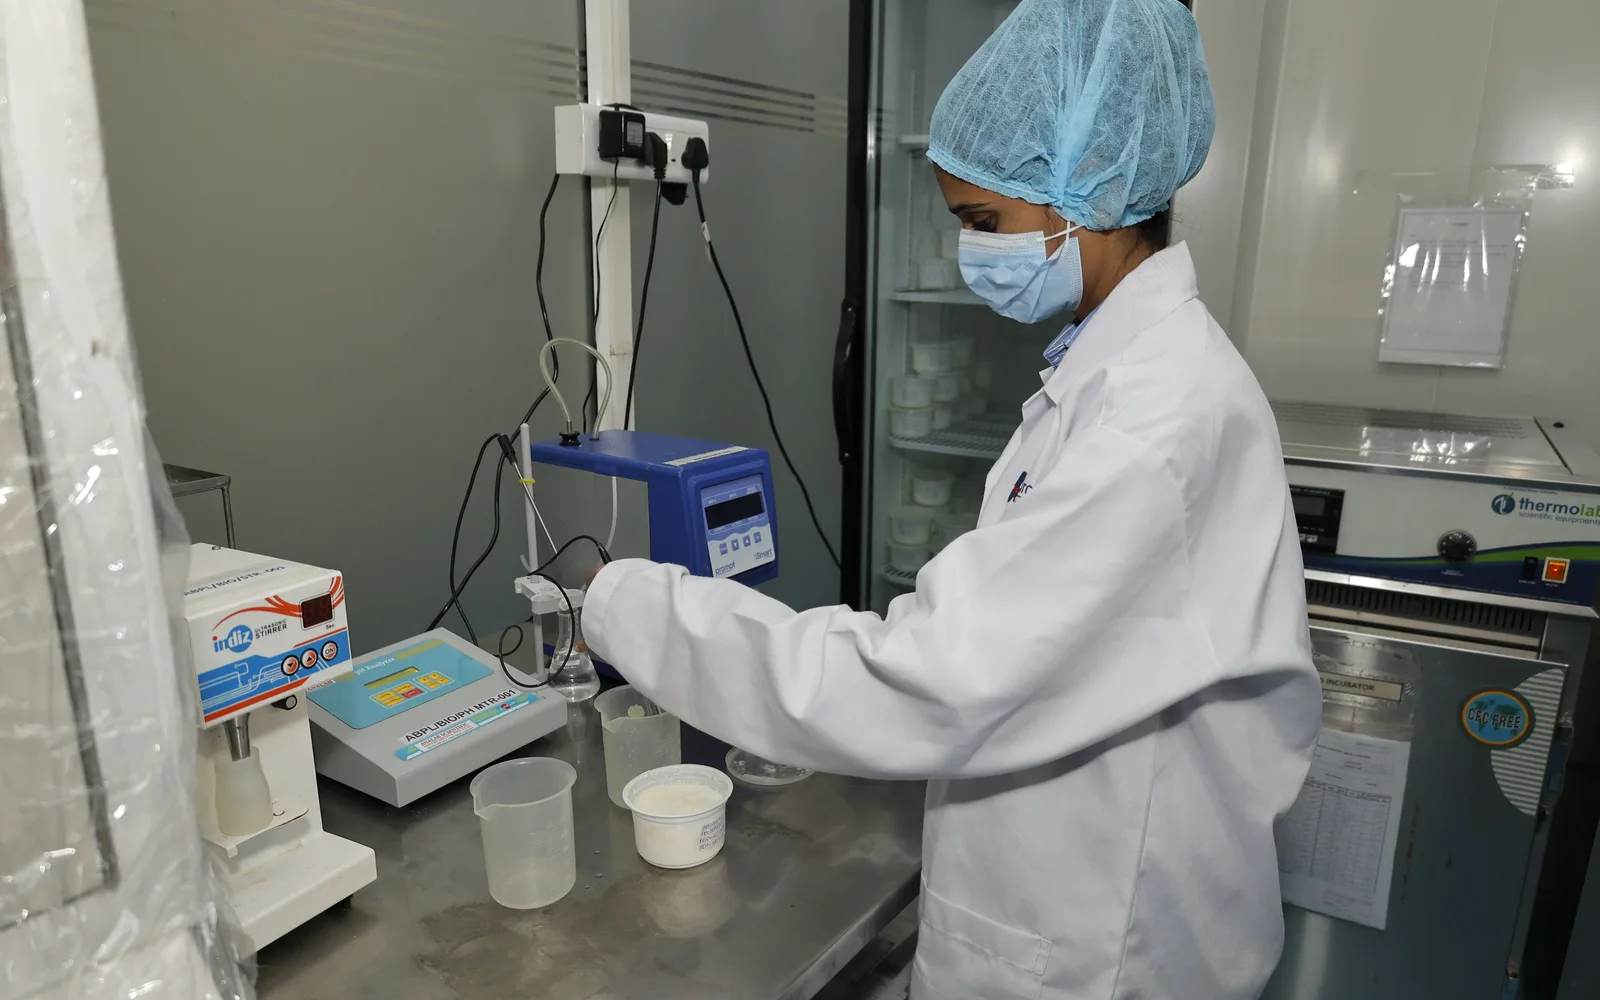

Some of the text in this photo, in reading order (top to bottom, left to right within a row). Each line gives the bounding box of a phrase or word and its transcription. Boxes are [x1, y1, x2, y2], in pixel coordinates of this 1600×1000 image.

[1518, 511, 1553, 520] scientific
[715, 561, 735, 576] prompt
[254, 618, 287, 633] ULTRASONIC
[255, 624, 287, 639] STIRRER
[212, 629, 253, 653] indiz
[325, 647, 334, 655] ON
[366, 657, 396, 671] Analyzer
[1325, 679, 1375, 692] INCUBATOR
[405, 707, 475, 742] ABPL/BIO/PH
[473, 689, 517, 711] MTR-001
[1468, 707, 1522, 729] CFC FREE
